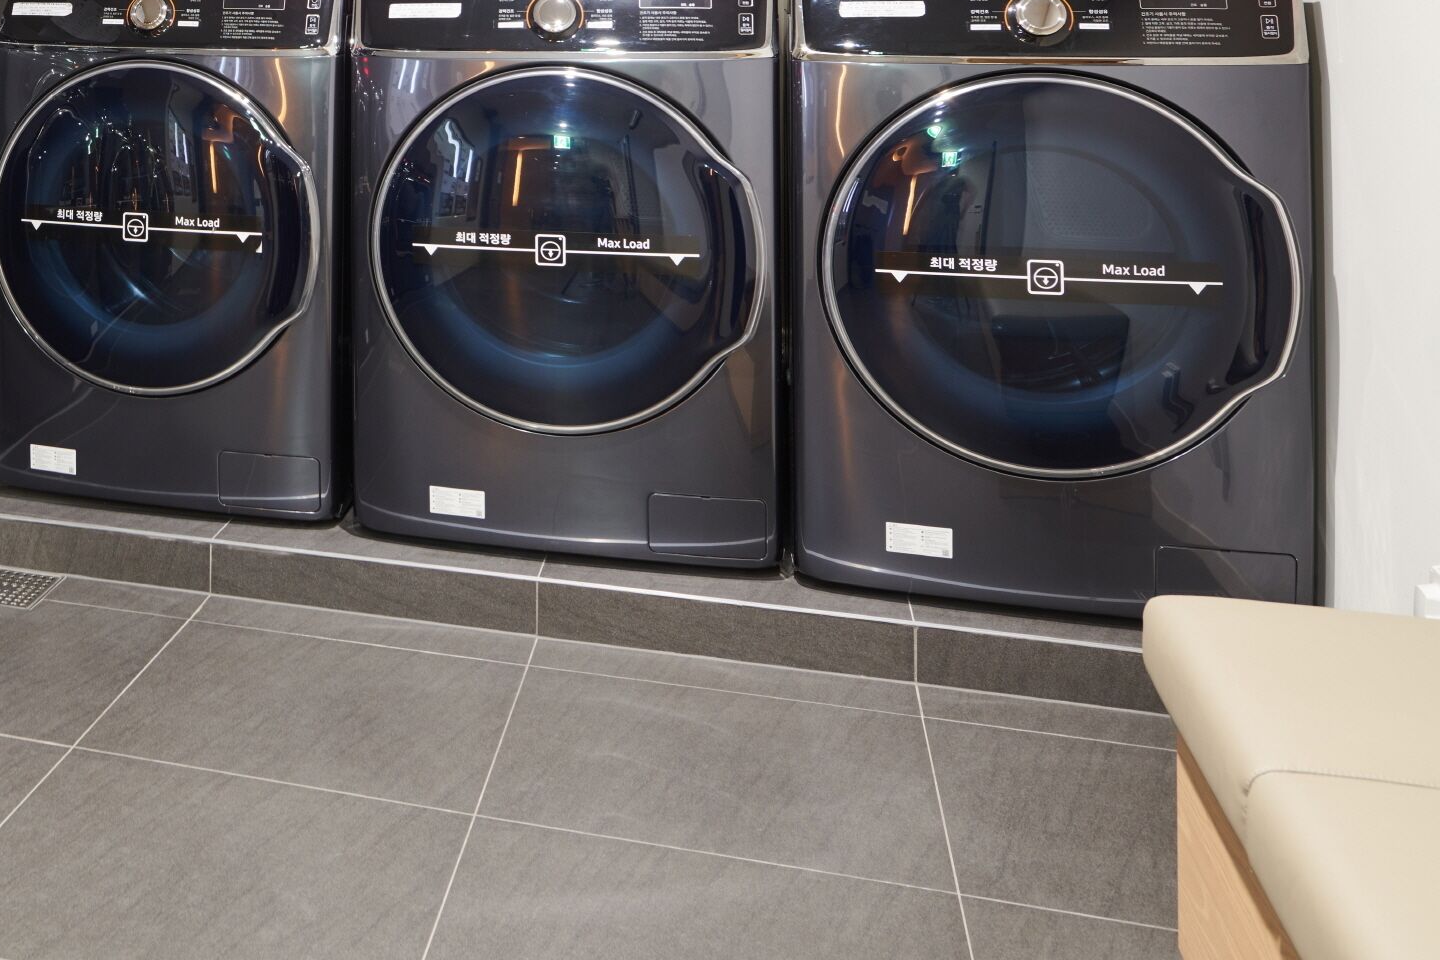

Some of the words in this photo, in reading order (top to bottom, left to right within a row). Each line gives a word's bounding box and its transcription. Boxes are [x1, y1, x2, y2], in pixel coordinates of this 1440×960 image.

[56, 208, 74, 219] 최대
[76, 210, 103, 222] 적정량
[175, 216, 195, 227] Max
[196, 217, 220, 228] Load
[455, 232, 476, 244] 최대
[478, 232, 512, 246] 적정량
[597, 237, 621, 249] Max
[623, 238, 650, 250] Load
[929, 256, 955, 270] 최대
[958, 257, 998, 272] 적정량
[1102, 263, 1130, 276] Max
[1133, 264, 1165, 277] Load
